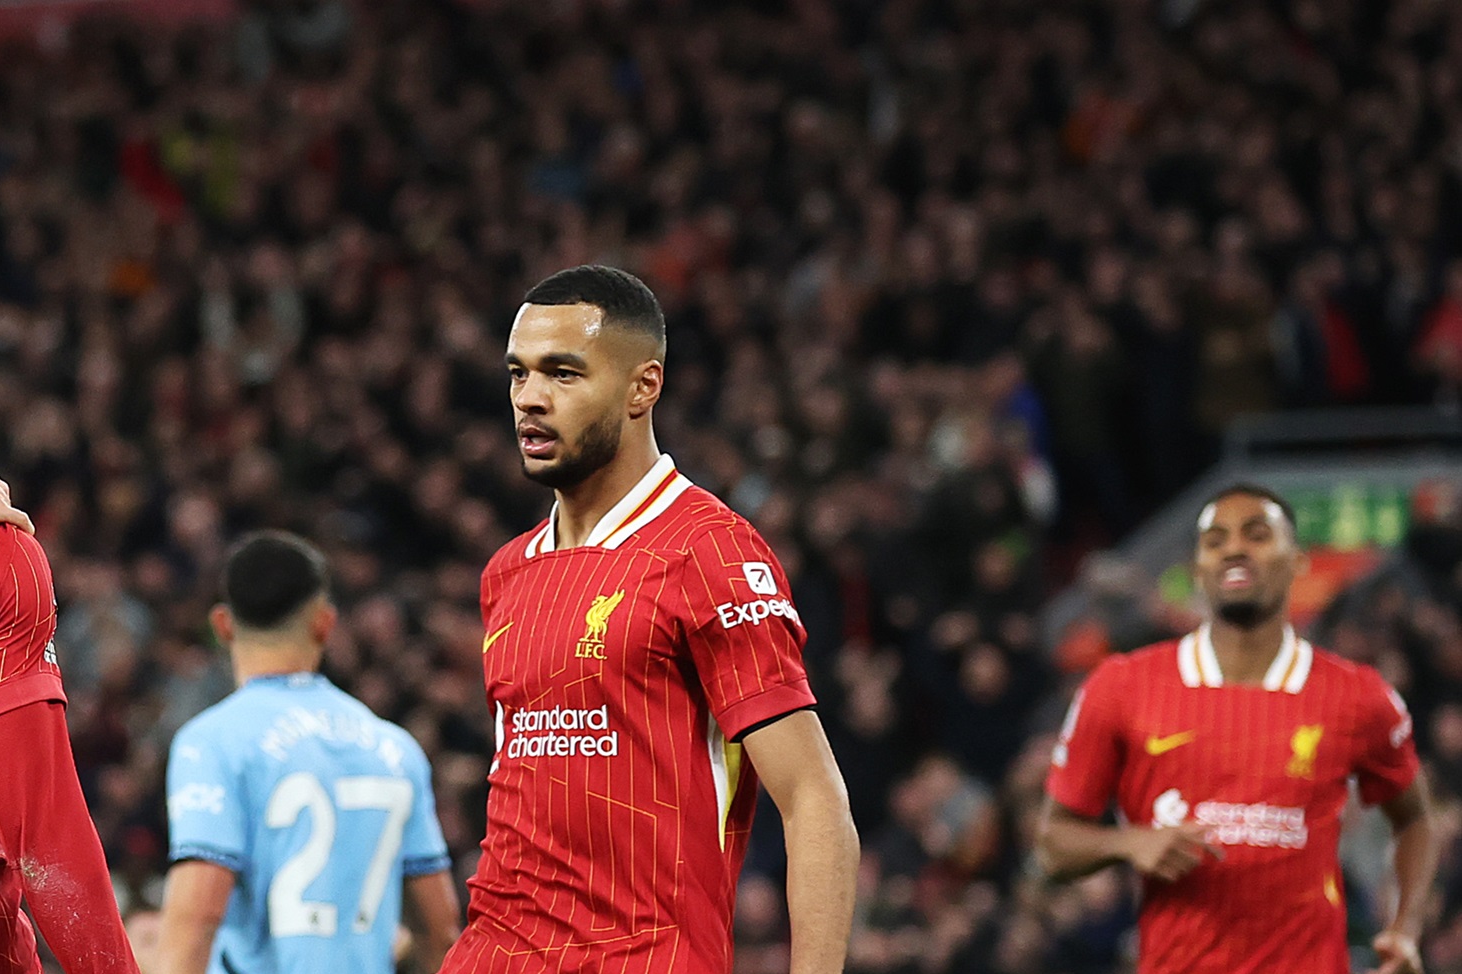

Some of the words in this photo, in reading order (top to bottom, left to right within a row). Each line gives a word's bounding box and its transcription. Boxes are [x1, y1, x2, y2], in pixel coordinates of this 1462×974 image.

[511, 704, 608, 733] standard
[507, 730, 618, 759] chartered
[266, 771, 414, 938] 27
